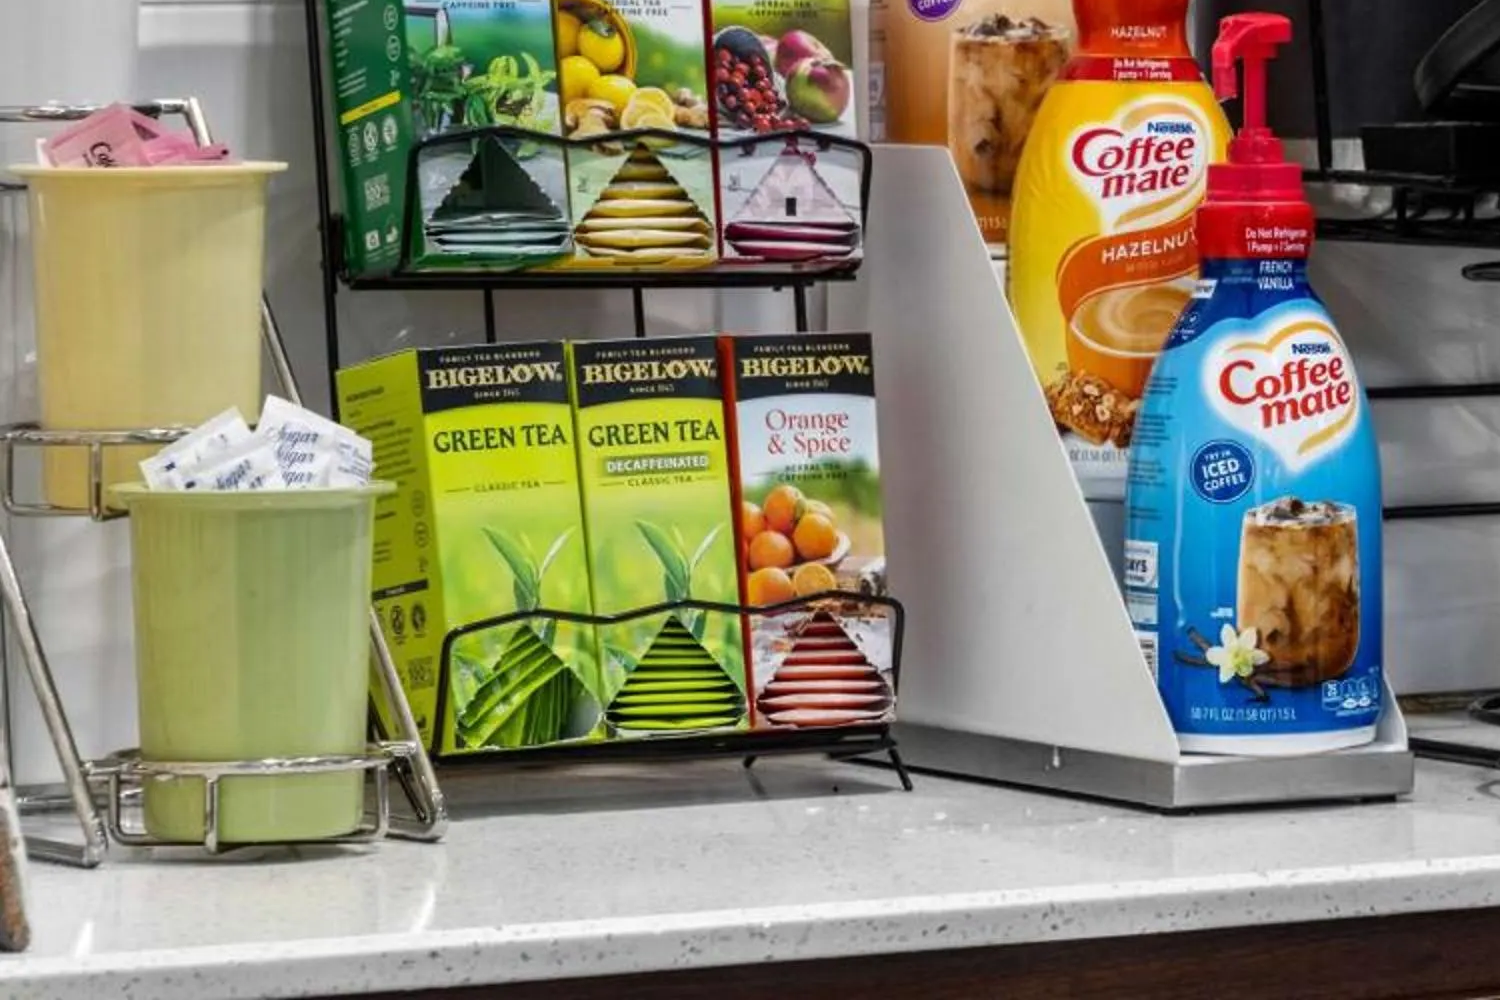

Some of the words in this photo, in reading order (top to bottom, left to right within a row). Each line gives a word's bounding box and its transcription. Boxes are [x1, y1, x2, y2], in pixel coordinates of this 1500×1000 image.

[442, 1, 490, 9] CAFFEINE
[1110, 25, 1168, 39] HAZELNUT
[1072, 128, 1195, 177] Coffee
[1101, 164, 1190, 199] mate
[1259, 261, 1293, 273] FRENCH
[1257, 277, 1294, 290] VANILLA
[426, 361, 561, 390] BIGELOW
[582, 358, 715, 385] BIGELOW
[741, 355, 870, 378] BIGELOW
[1219, 356, 1344, 405] Coffee
[1260, 380, 1351, 429] mate
[765, 408, 849, 434] Orange
[433, 429, 516, 453] GREEN
[521, 424, 566, 447] TEA
[588, 421, 671, 448] GREEN
[675, 419, 720, 442] TEA
[767, 433, 786, 455] &
[793, 430, 851, 458] Spice
[606, 454, 709, 473] DECAFFEINATED
[1202, 458, 1240, 479] ICED
[474, 482, 515, 493] CLASSIC
[520, 479, 541, 490] TEA
[628, 476, 669, 487] CLASSIC
[673, 475, 693, 485] TEA
[1204, 473, 1246, 493] COFFEE
